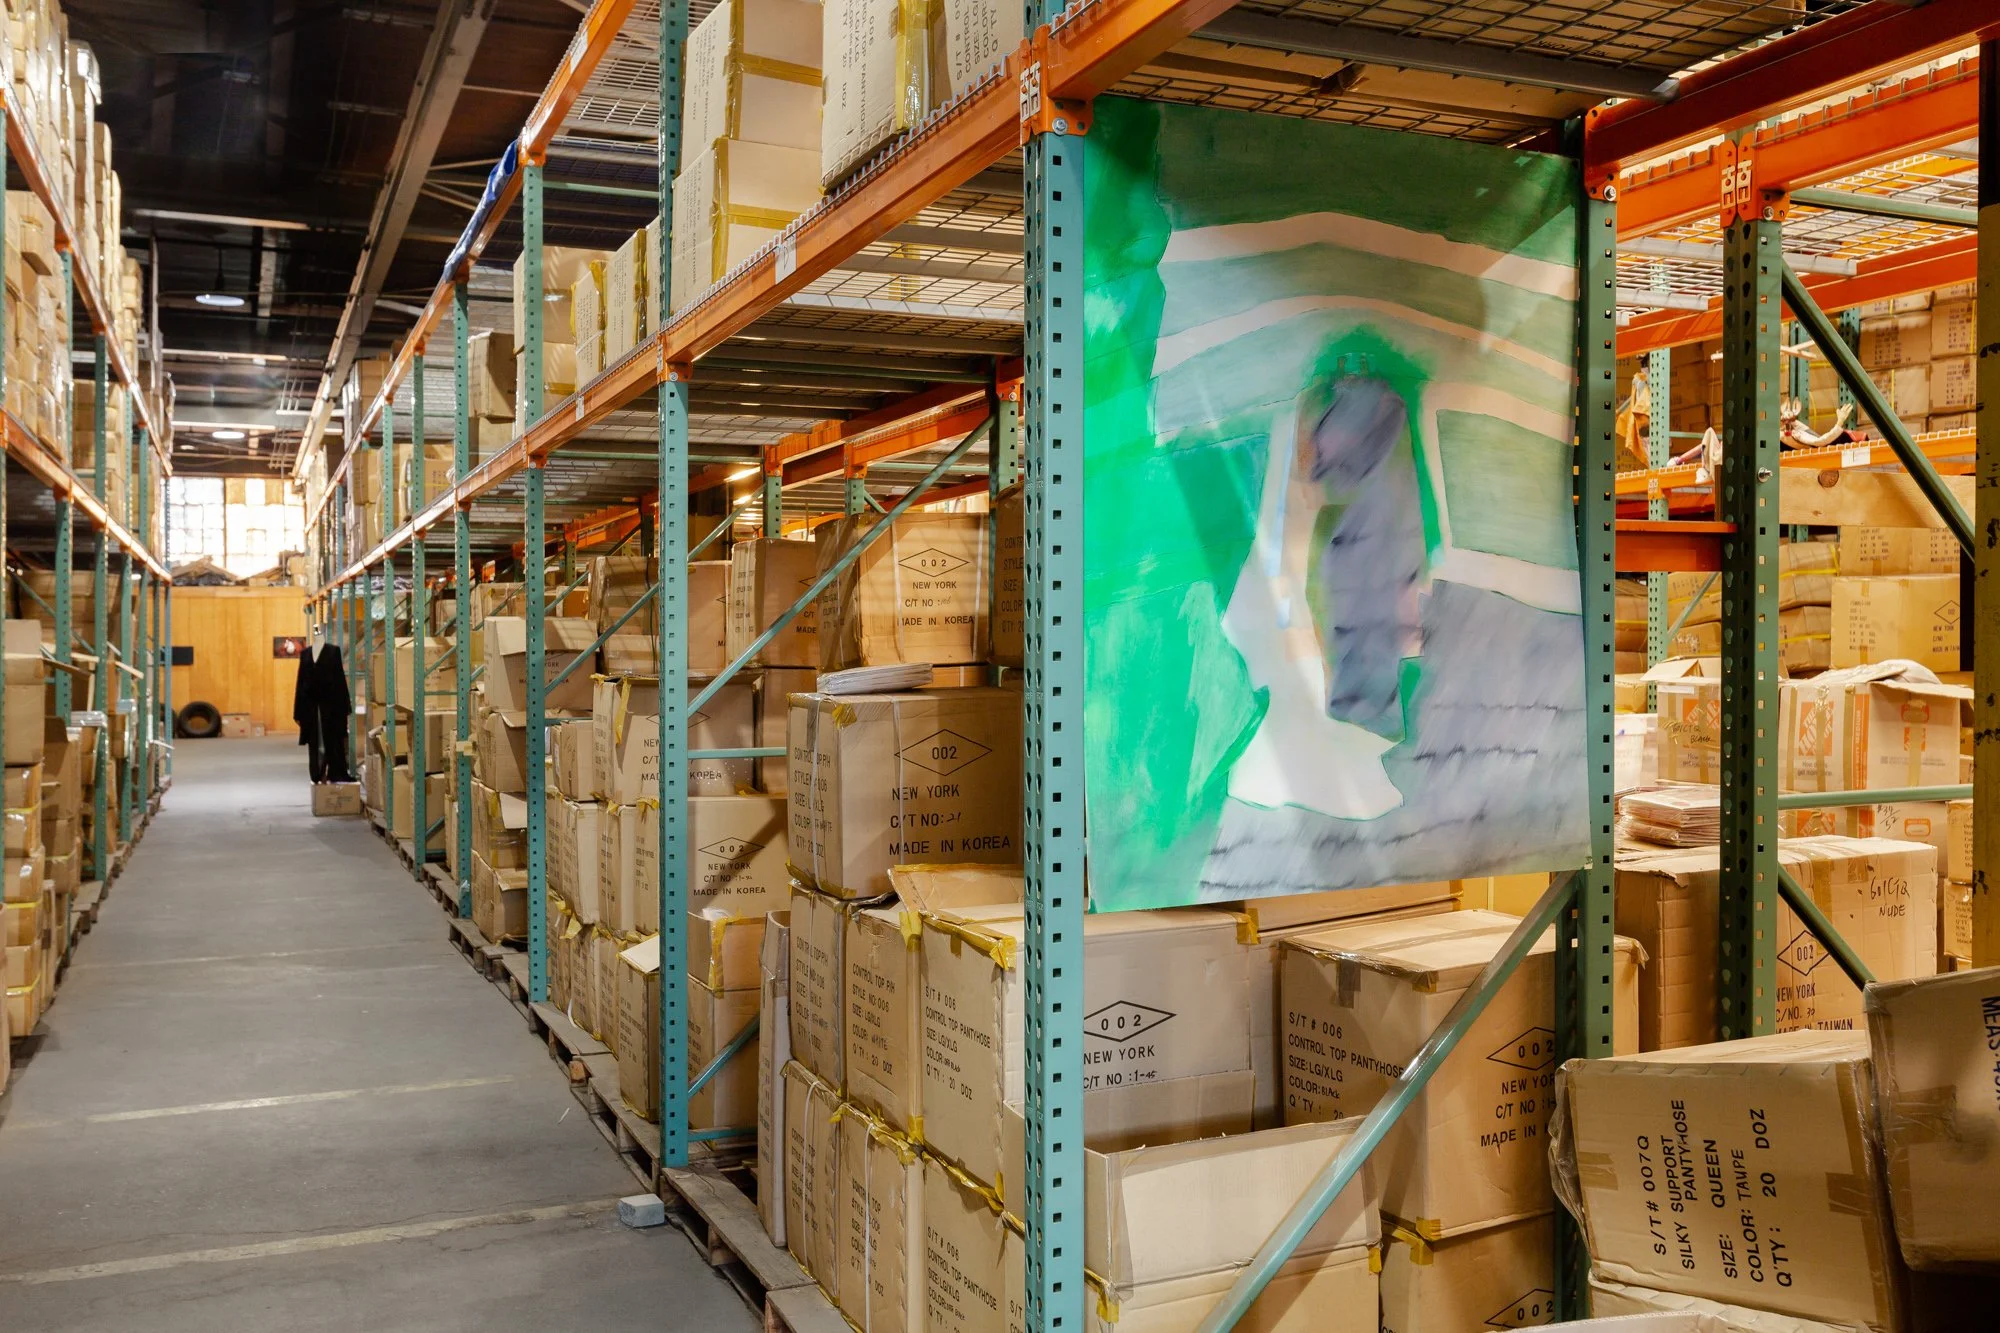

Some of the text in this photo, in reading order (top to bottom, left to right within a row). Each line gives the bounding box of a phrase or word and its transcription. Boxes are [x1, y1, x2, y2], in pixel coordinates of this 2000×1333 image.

[912, 581, 957, 589] NEW YORK
[904, 598, 934, 607] C/T NO
[928, 617, 937, 625] IN
[944, 615, 975, 625] KOREA
[796, 626, 817, 634] MADE
[642, 756, 659, 765] C/T
[931, 747, 957, 760] 002
[641, 773, 660, 781] MAD
[892, 784, 960, 801] NEW YORK
[720, 845, 744, 853] 002
[889, 835, 1011, 856] MADE IN KOREA
[729, 862, 751, 870] YORK
[704, 875, 715, 883] C/T
[693, 888, 718, 896] MADE
[723, 887, 732, 895] IN
[1879, 904, 1906, 917] NUDE
[1796, 945, 1814, 962] 002
[852, 963, 873, 985] CONTROL
[875, 974, 885, 988] TOP
[852, 983, 866, 1001] STYLE
[925, 985, 936, 1001] S/T
[1796, 982, 1816, 999] YORK
[925, 1006, 991, 1049] CONTROL TOP PANTYHOSE
[1101, 1014, 1142, 1031] 002
[1289, 1011, 1343, 1040] S/T # 006
[1083, 1044, 1155, 1065] NEW YORK
[1288, 1033, 1404, 1079] CONTROL TOP PANTYHOSE
[1518, 1040, 1554, 1058] 002
[949, 1076, 956, 1090] 20
[1083, 1075, 1100, 1089] C/T
[1106, 1072, 1123, 1086] NO
[1501, 1073, 1556, 1095] NEW YOR
[1289, 1094, 1314, 1113] Q'TY
[1495, 1099, 1536, 1119] C/T NO
[1480, 1129, 1517, 1147] MADE
[1524, 1125, 1536, 1138] IN
[1750, 1108, 1770, 1150] DOZ
[1671, 1099, 1698, 1201] PANTYHOSE
[1760, 1172, 1777, 1198] 20
[1637, 1135, 1667, 1256] S/T # 007Q
[1660, 1135, 1695, 1270] SILKY SUPPORT
[1703, 1139, 1738, 1279] SIZE: QUEEN
[1731, 1148, 1764, 1283] COLOR: TAUPE
[927, 1226, 938, 1244] S/T
[1769, 1238, 1793, 1287] Q'TY
[927, 1247, 997, 1311] CONTROL TOP PANTYHOSE
[1517, 1300, 1554, 1321] 002
